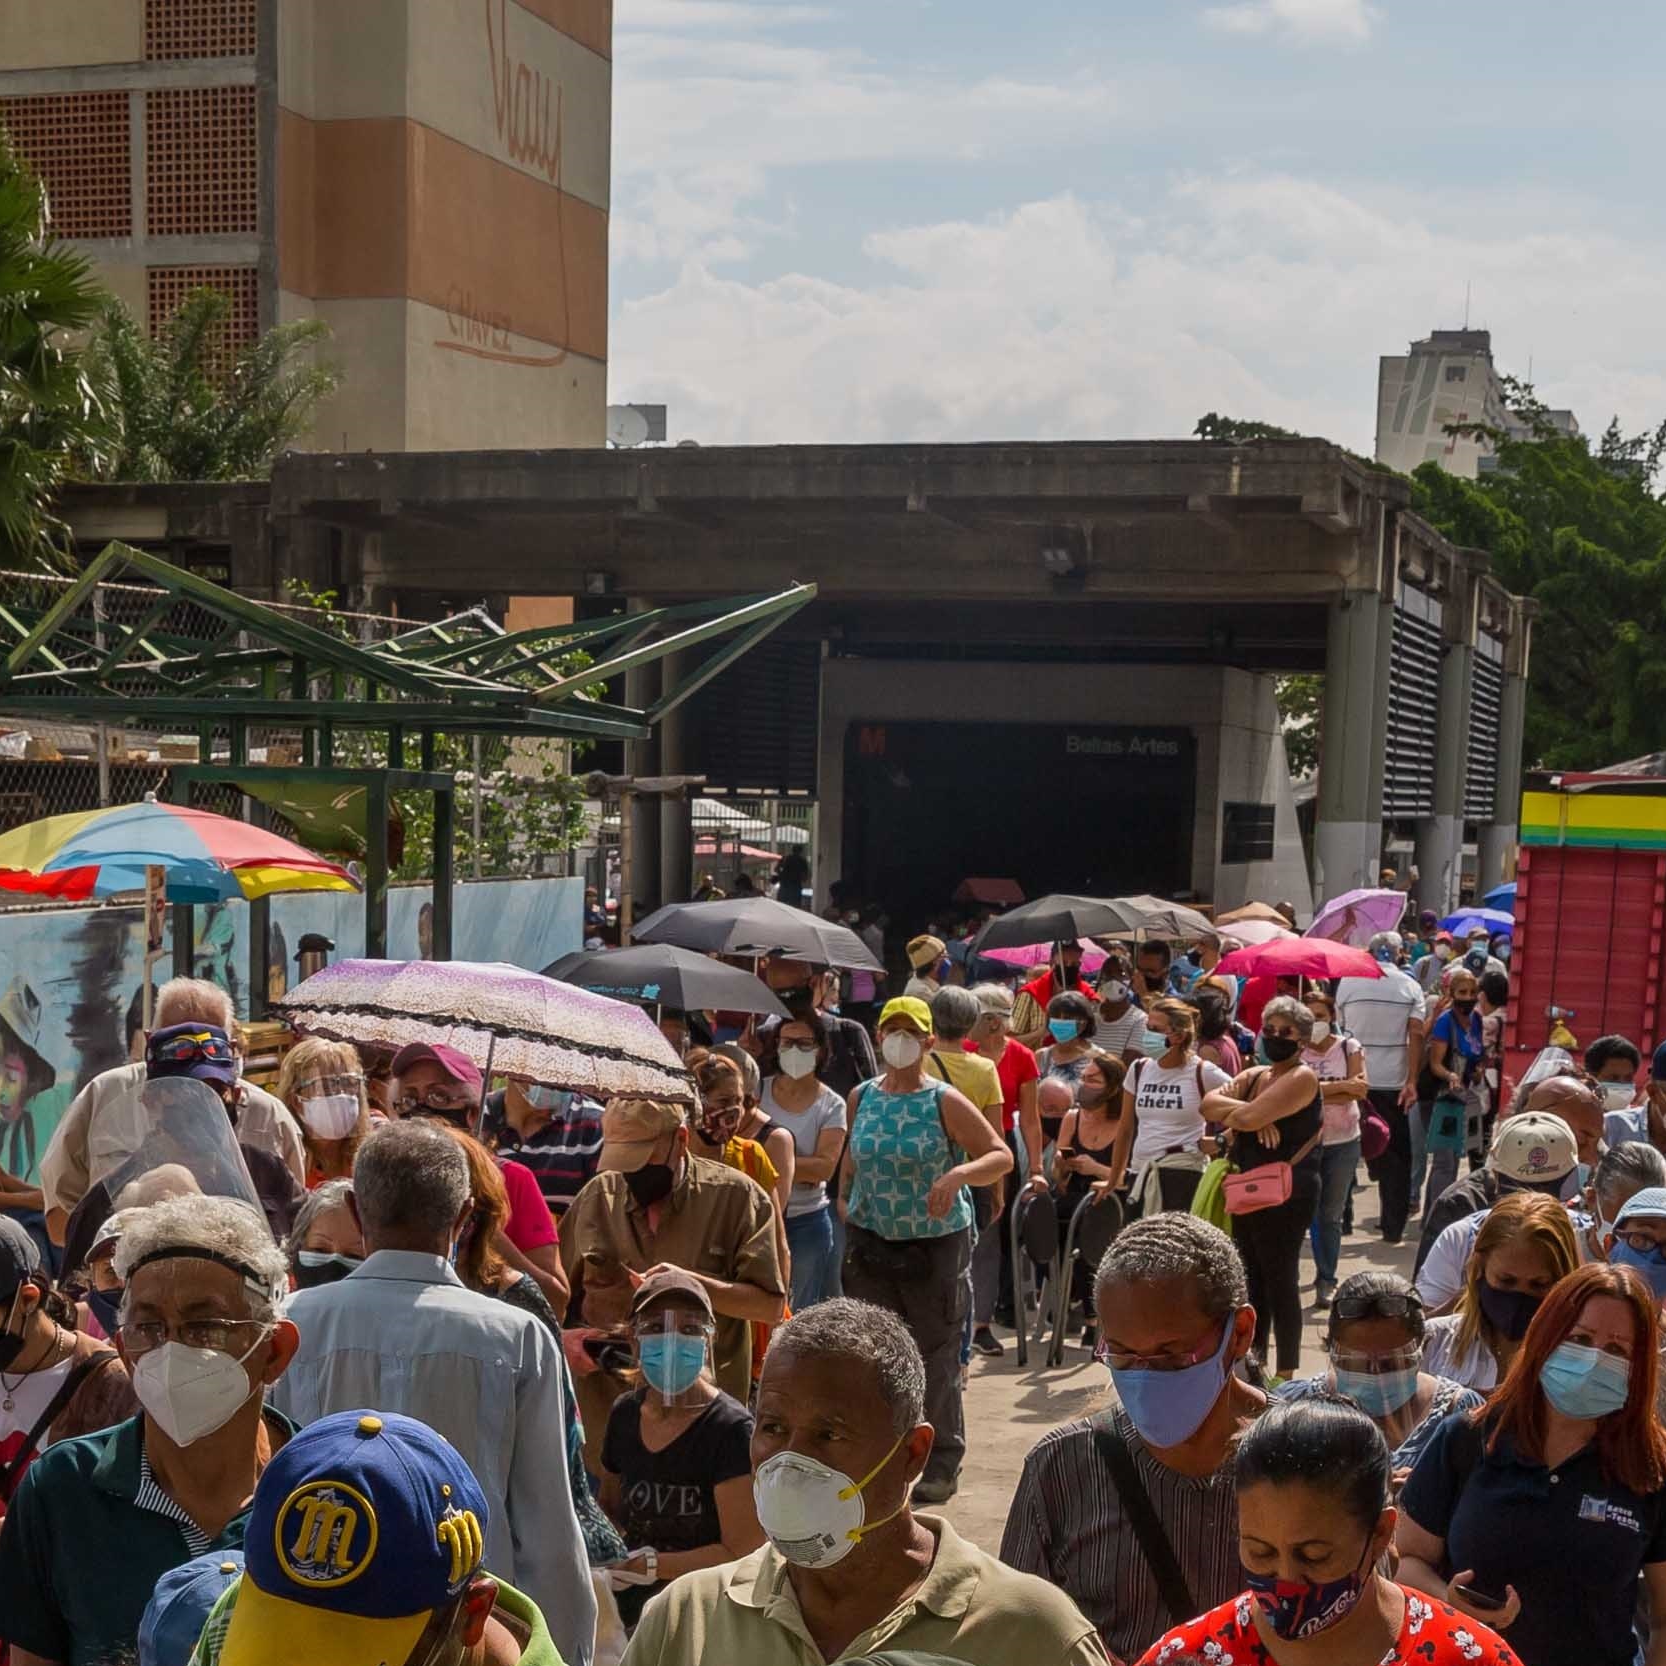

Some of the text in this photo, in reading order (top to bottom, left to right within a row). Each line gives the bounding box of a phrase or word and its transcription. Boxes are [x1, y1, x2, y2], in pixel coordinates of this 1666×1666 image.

[1066, 735, 1179, 755] Bellas Artes
[1142, 1082, 1181, 1094] mon
[1137, 1094, 1184, 1110] chéri
